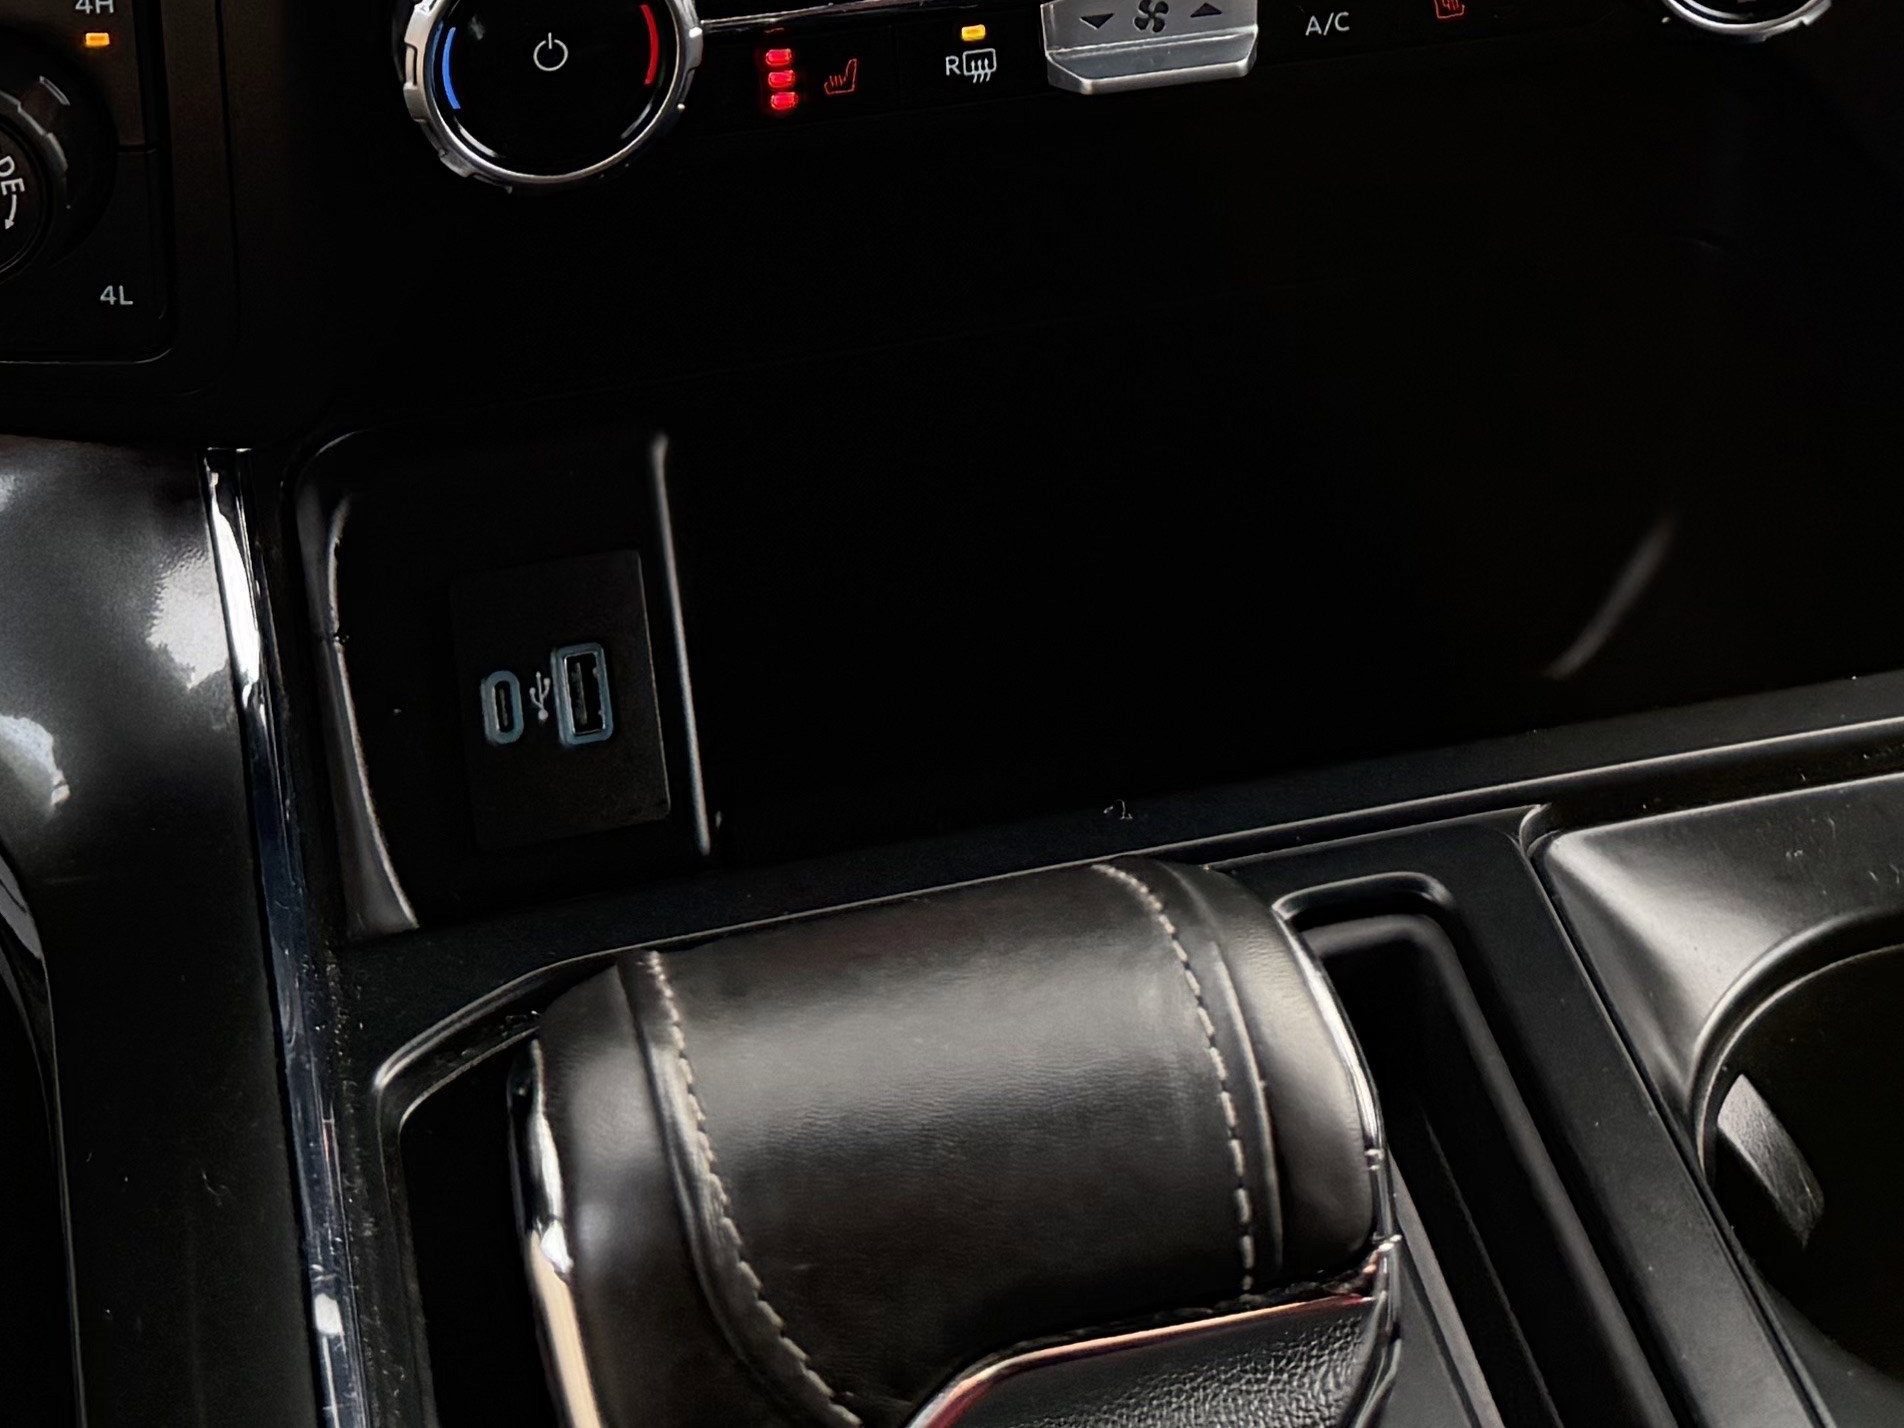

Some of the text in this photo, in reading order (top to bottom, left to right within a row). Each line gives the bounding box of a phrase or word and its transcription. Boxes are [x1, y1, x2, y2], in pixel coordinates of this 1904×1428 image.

[1305, 10, 1350, 37] A/C
[944, 55, 960, 77] R
[99, 285, 135, 307] 4L
